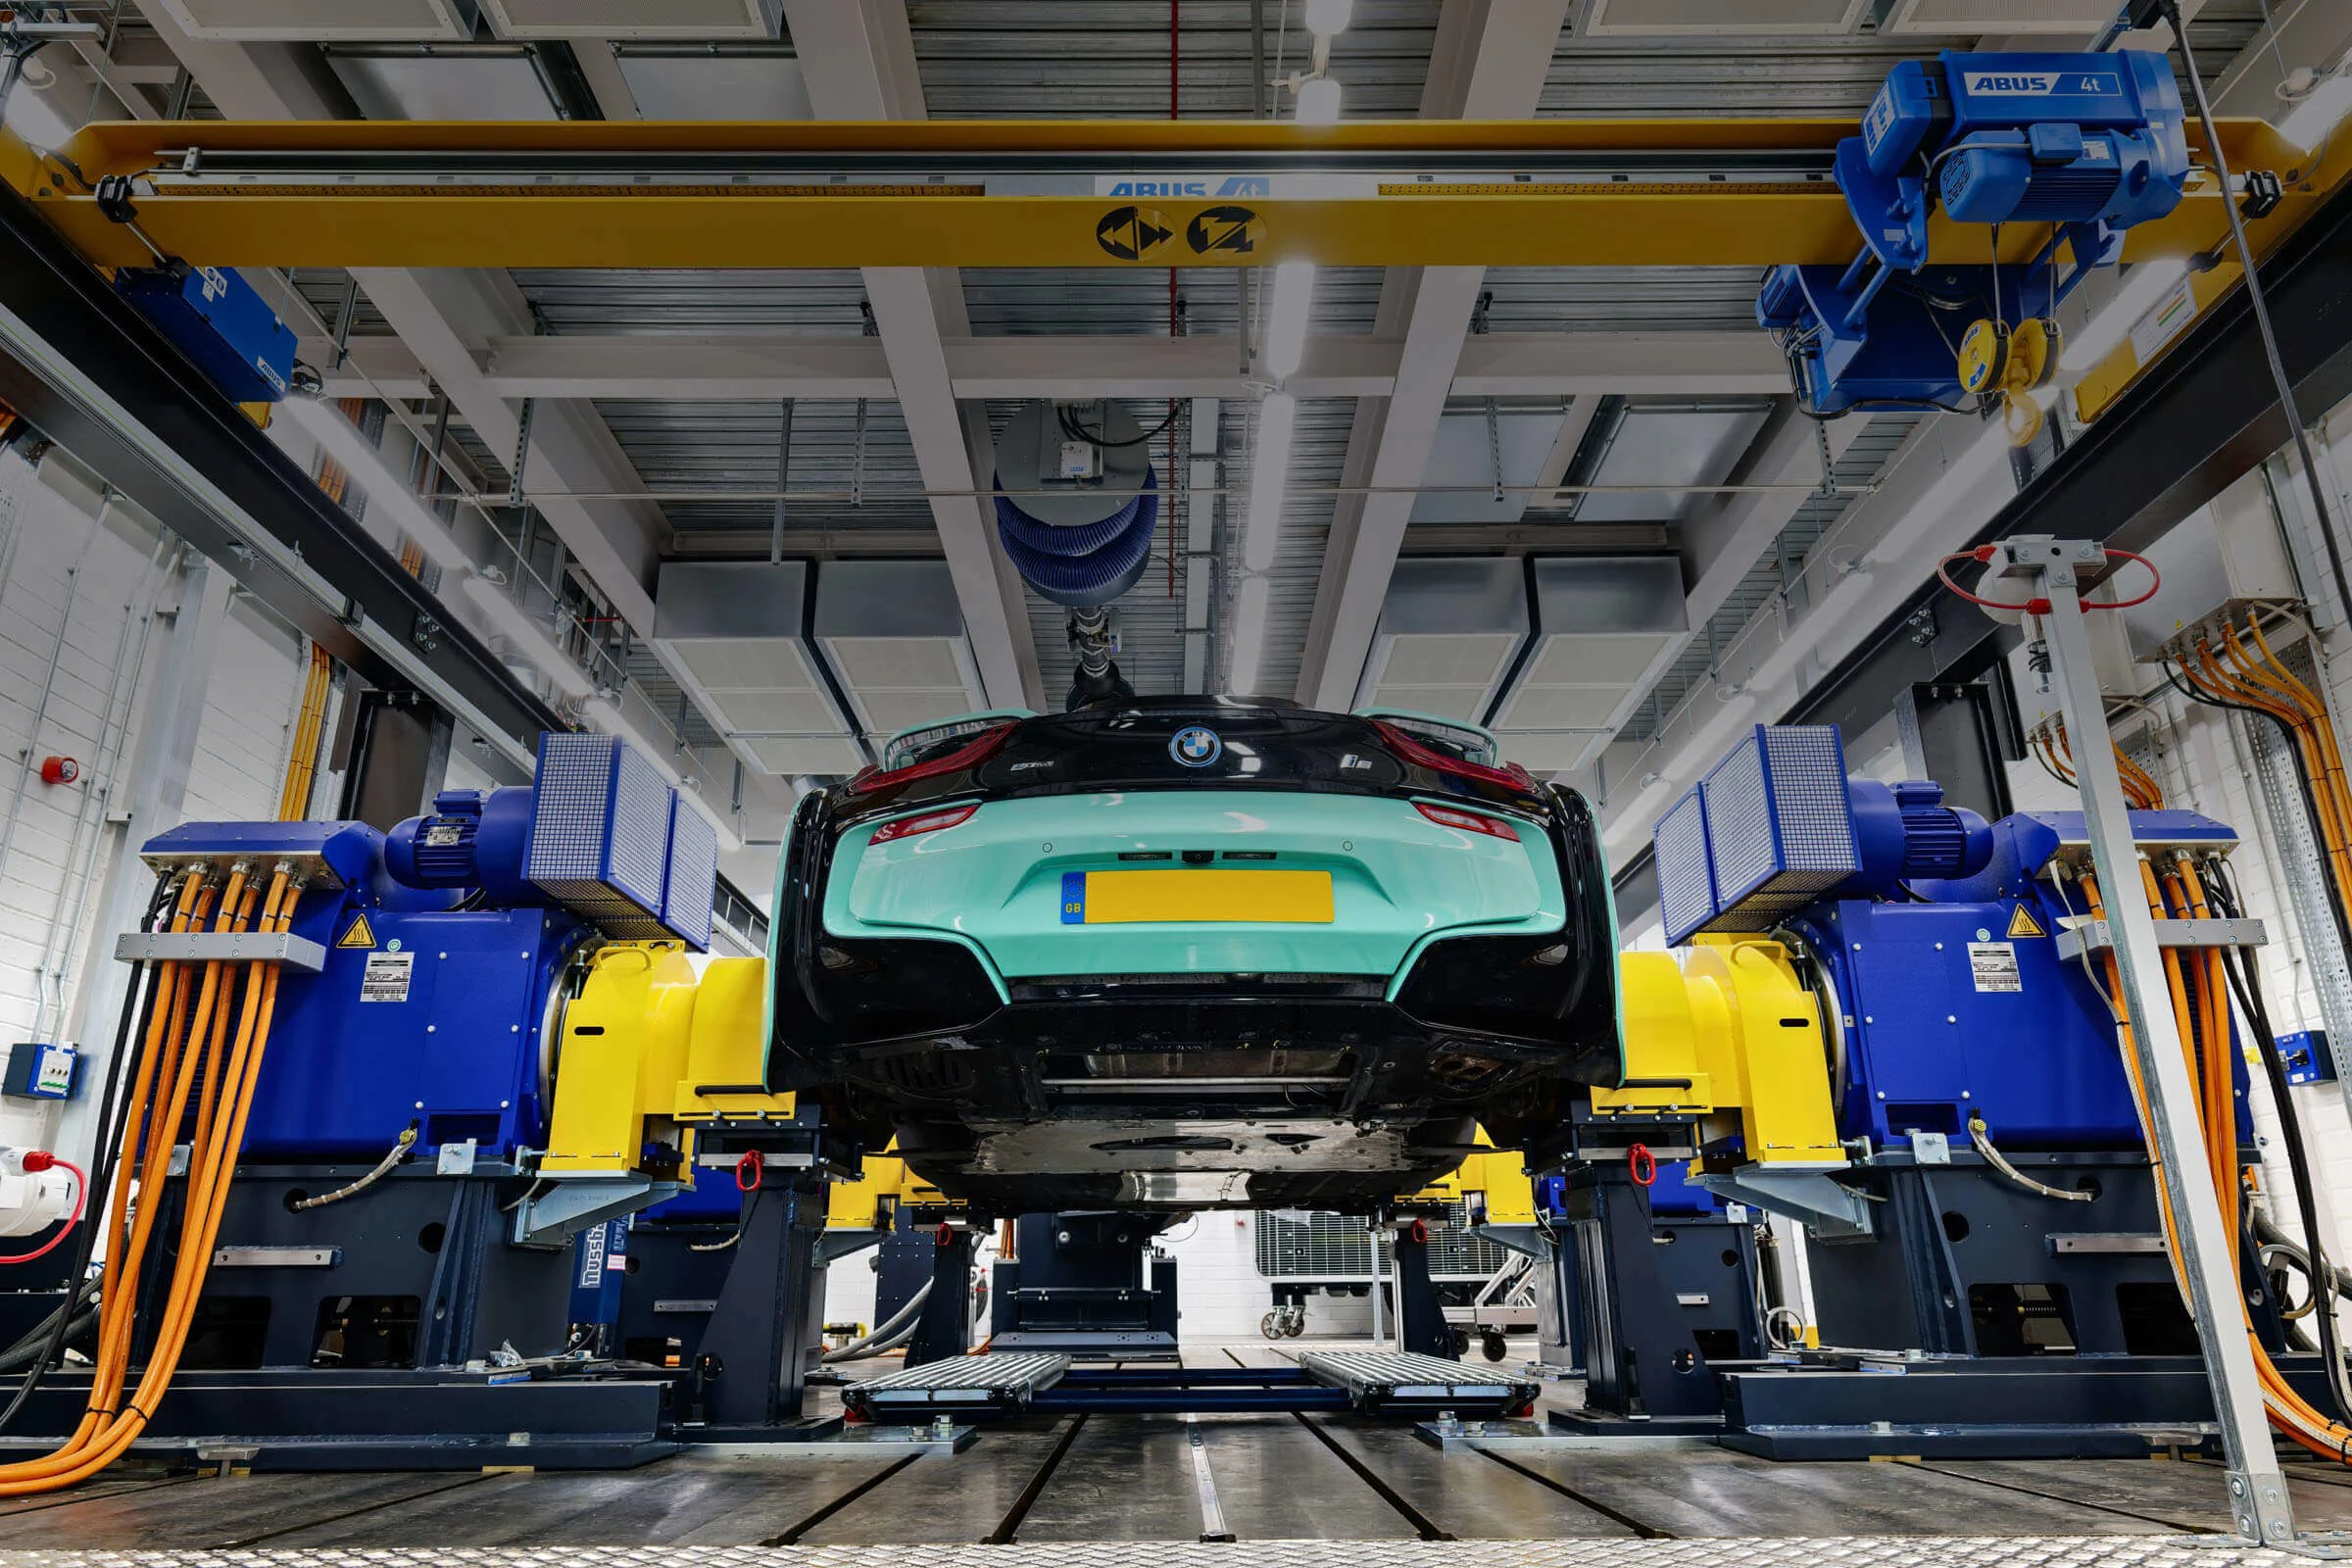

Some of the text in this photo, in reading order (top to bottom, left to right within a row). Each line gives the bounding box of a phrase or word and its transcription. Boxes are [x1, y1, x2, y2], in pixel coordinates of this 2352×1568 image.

[1974, 77, 2101, 91] ABUS 4t
[1109, 183, 1206, 196] ABUS
[1065, 903, 1082, 913] GB
